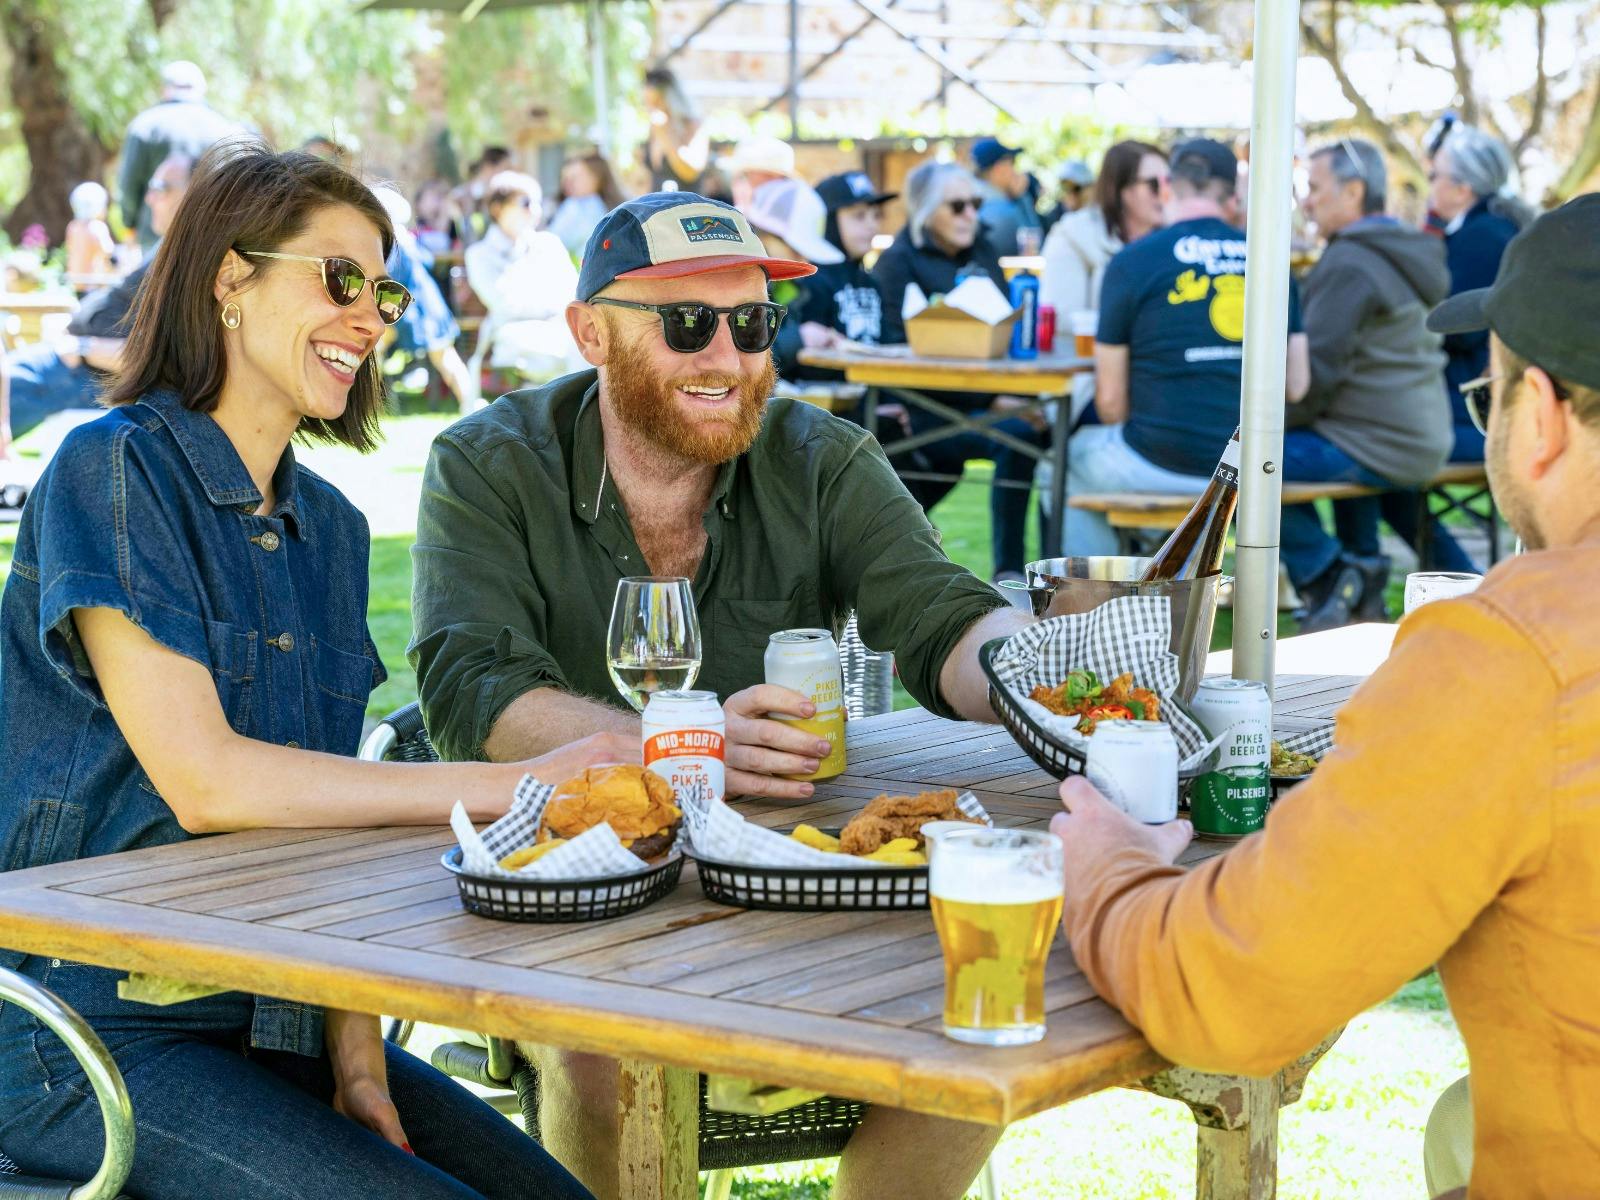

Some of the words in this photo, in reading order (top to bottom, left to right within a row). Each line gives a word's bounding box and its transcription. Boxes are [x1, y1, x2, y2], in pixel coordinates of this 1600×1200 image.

[656, 732, 720, 750] MID-NORTH
[1236, 733, 1263, 744] PIKES
[1230, 745, 1255, 756] BEER
[1226, 786, 1266, 799] PILSENER
